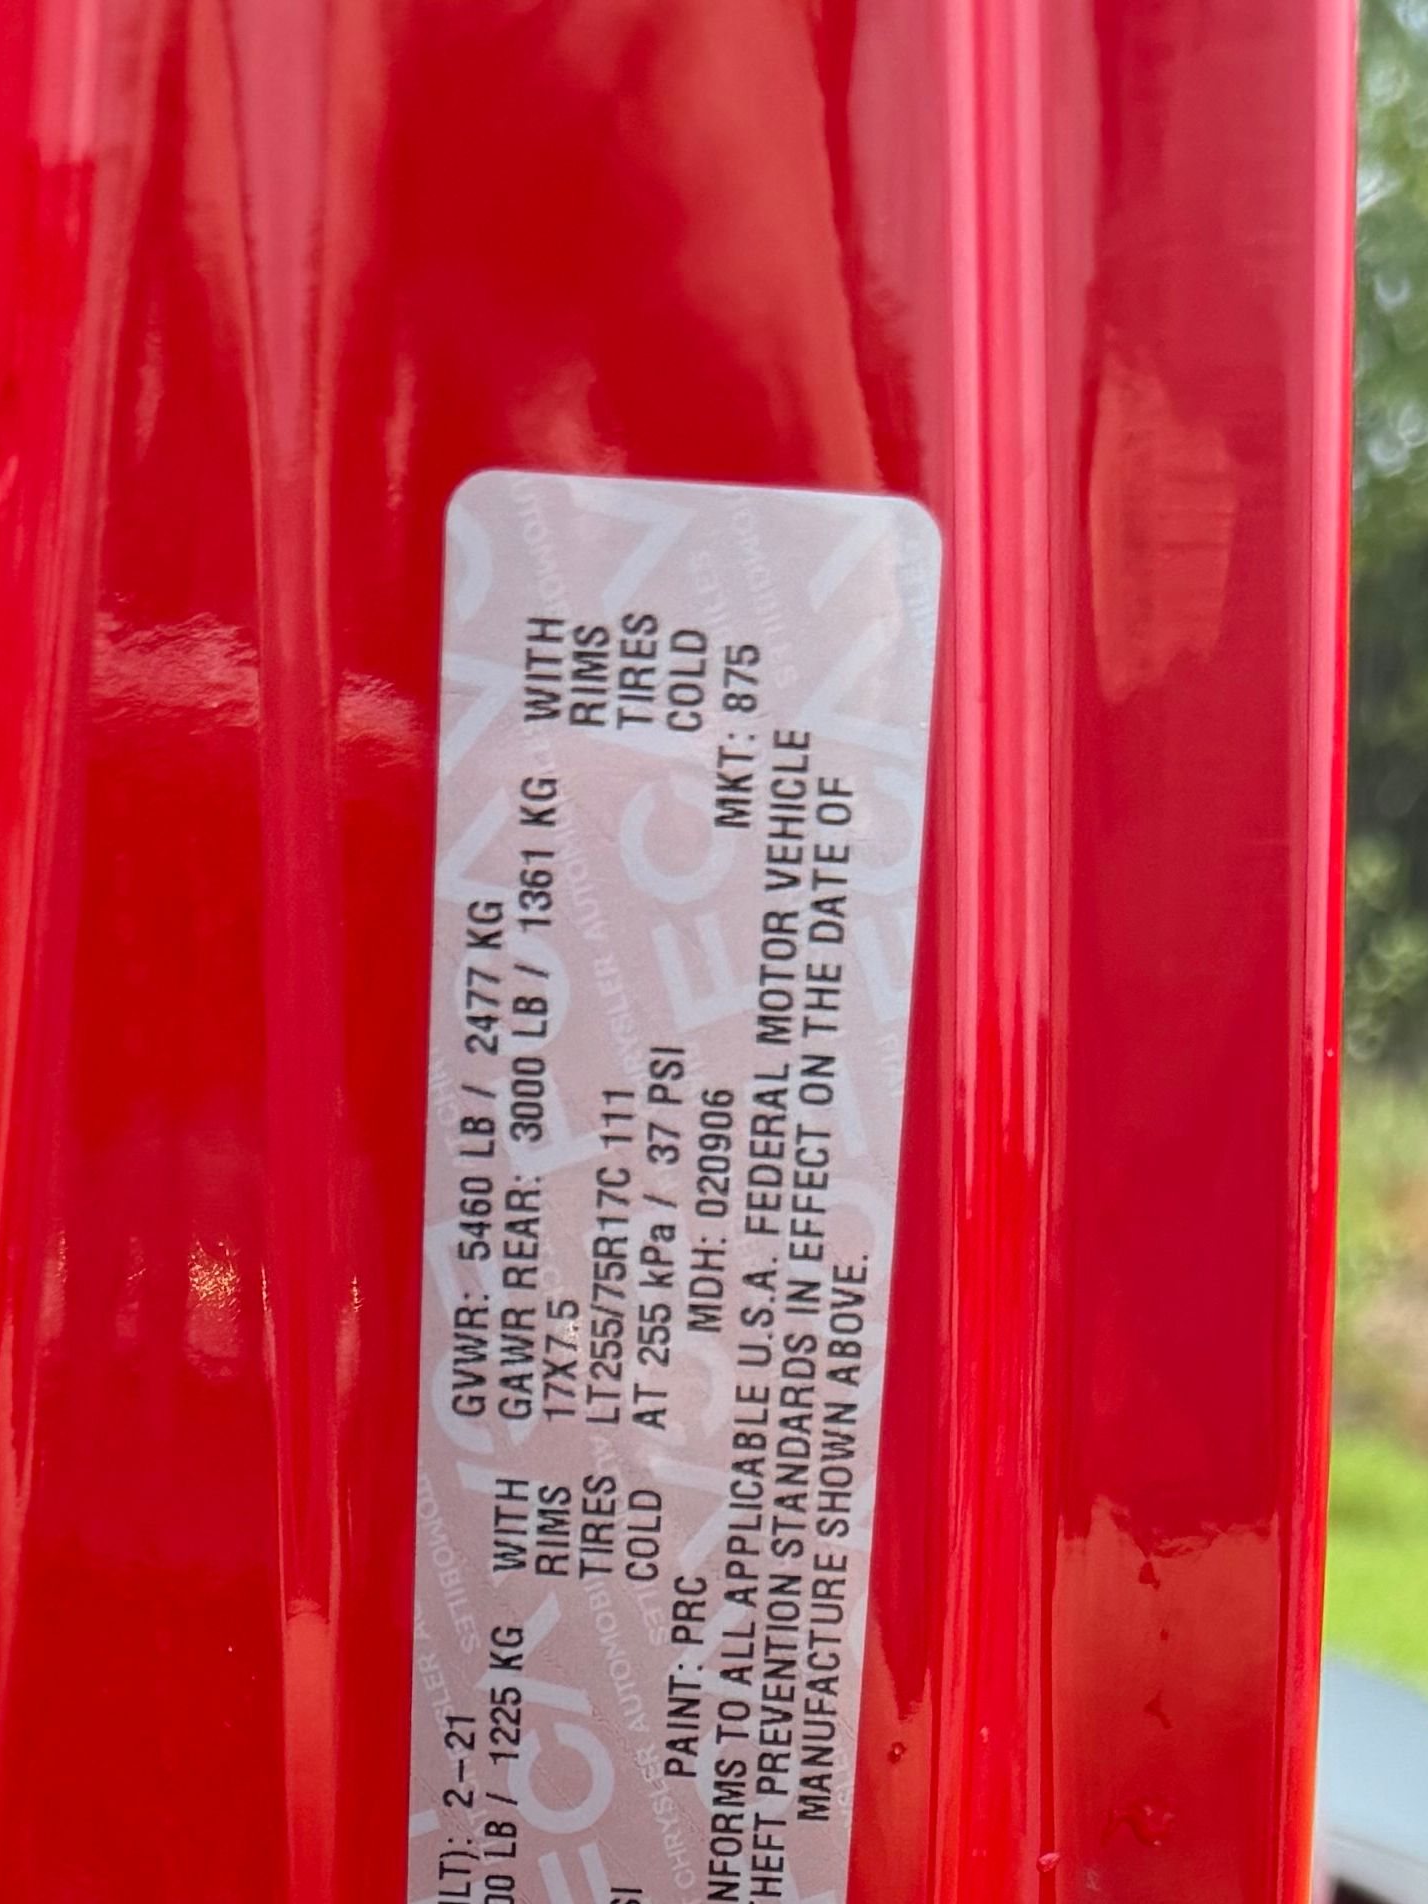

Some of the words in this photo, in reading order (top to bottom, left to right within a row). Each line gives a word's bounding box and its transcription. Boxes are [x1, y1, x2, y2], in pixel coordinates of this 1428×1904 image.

[524, 617, 566, 722] WITH
[569, 625, 610, 727] RIMS
[616, 613, 658, 730] TIRES
[666, 629, 708, 732] COLD
[722, 644, 760, 713] 875
[519, 777, 559, 827] KG
[714, 732, 757, 828] MKT:
[764, 730, 811, 892] VEHICLE
[816, 777, 853, 826] OF
[466, 901, 504, 950] KG
[517, 850, 556, 933] 1361
[808, 844, 850, 944] DATE
[464, 966, 502, 1056] 2477
[511, 996, 548, 1038] LB
[756, 911, 799, 1045] MOTOR
[802, 963, 842, 1038] THE
[510, 1057, 546, 1143] 3000
[599, 1090, 636, 1148] 111
[647, 1047, 686, 1105] PSI
[799, 1054, 836, 1106] ON
[458, 1116, 495, 1158] LB
[646, 1121, 681, 1165] 37
[695, 1089, 735, 1218] 020906
[745, 1062, 790, 1235] FEDERAL
[457, 1177, 493, 1261] 5460
[502, 1175, 545, 1290] REAR:
[789, 1123, 832, 1262] EFFECT
[586, 1167, 631, 1424] LT255/75R17C
[639, 1224, 676, 1288] kPa
[687, 1236, 727, 1333] MDH:
[785, 1280, 821, 1314] IN
[452, 1291, 490, 1417] GVWR:
[637, 1303, 672, 1367] 255
[737, 1256, 778, 1367] U.S.A.
[826, 1255, 869, 1387] ABOVE.
[498, 1307, 536, 1420] GAWR
[542, 1300, 579, 1422] 17X7.5
[632, 1382, 668, 1431] AT
[771, 1333, 817, 1558] STANDARDS
[816, 1402, 858, 1538] SHOWN
[493, 1479, 529, 1572] WITH
[535, 1485, 571, 1576] RIMS
[579, 1474, 616, 1580] TIRES
[625, 1490, 662, 1581] COLD
[724, 1385, 770, 1608] APPLICABLE
[489, 1626, 524, 1672] KG
[671, 1576, 707, 1645] PRC
[719, 1620, 756, 1686] ALL
[488, 1687, 522, 1765] 1225
[664, 1664, 705, 1777] PAINT:
[716, 1700, 751, 1744] TO
[756, 1574, 802, 1796] PREVENTION
[797, 1553, 848, 1821] MANUFACTURE
[442, 1716, 476, 1808] 2-21
[484, 1821, 517, 1858] LB
